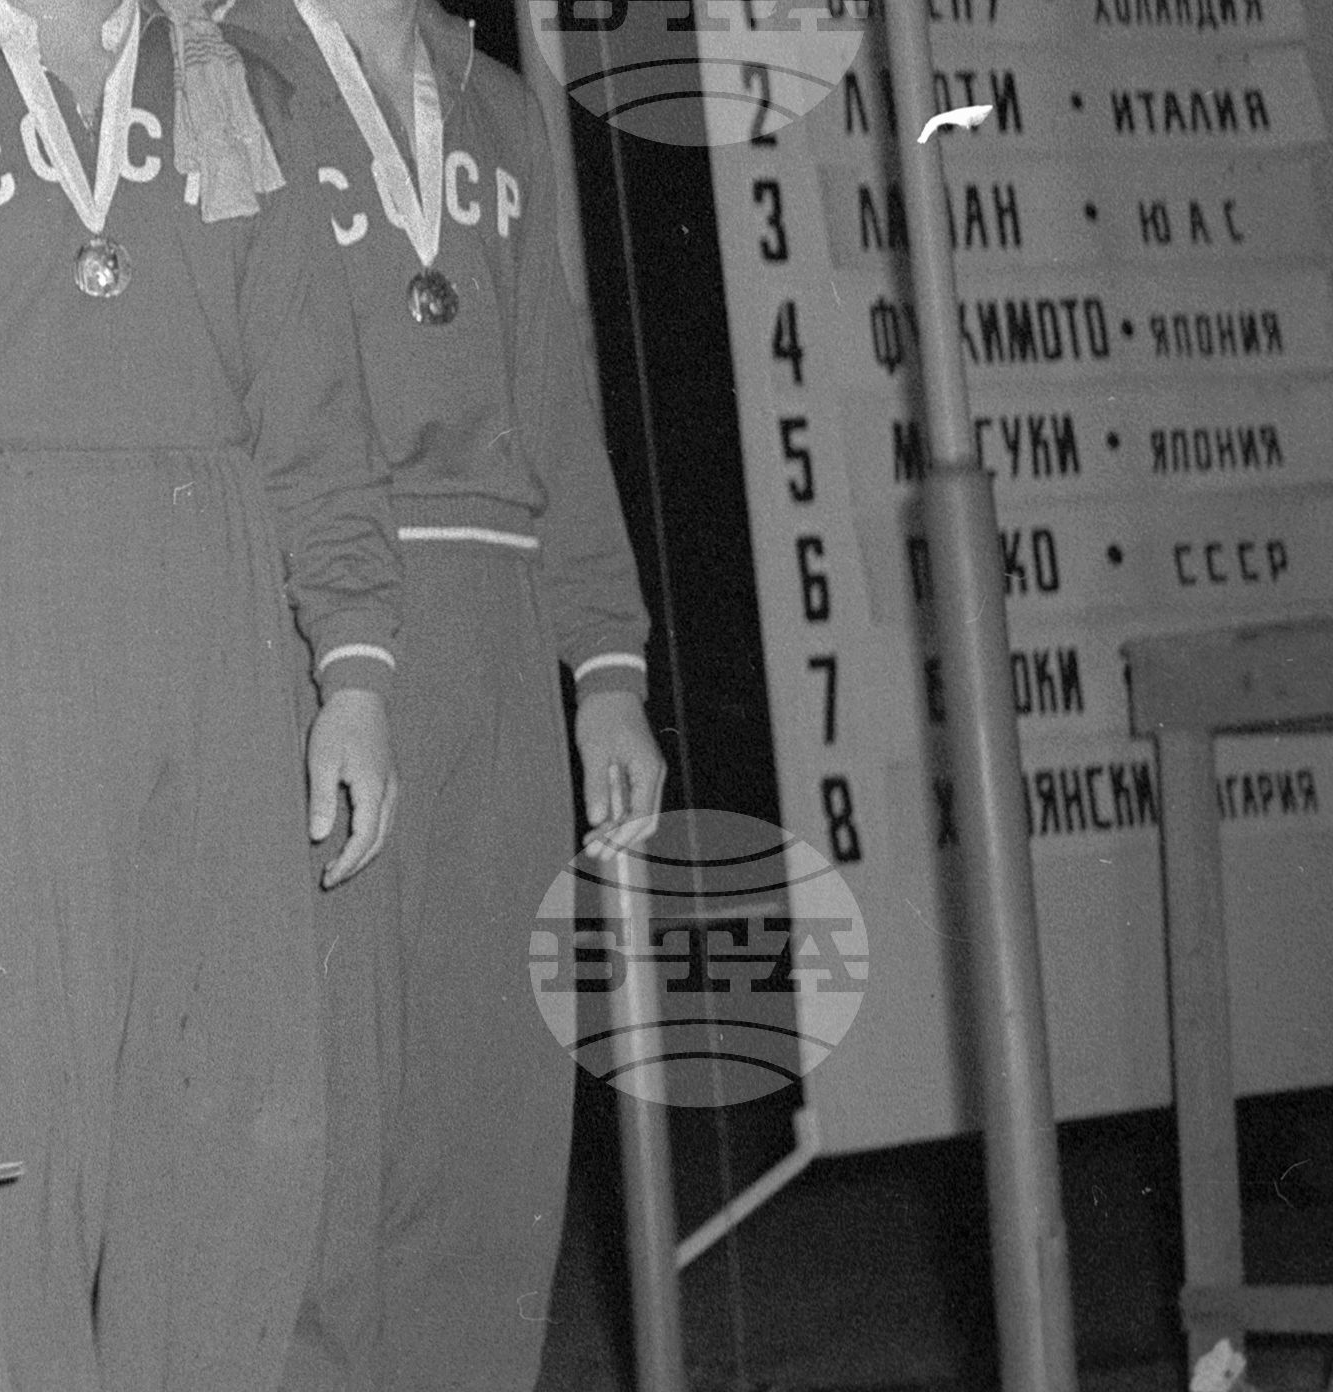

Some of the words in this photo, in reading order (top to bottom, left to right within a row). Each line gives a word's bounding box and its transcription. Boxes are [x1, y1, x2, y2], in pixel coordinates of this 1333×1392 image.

[741, 61, 778, 146] 2
[1111, 90, 1270, 134] ИТАЛИЯ
[753, 178, 788, 263] 3
[773, 301, 803, 385] 4
[1149, 310, 1284, 357] ЯПОНИЯ
[779, 416, 815, 503] 5
[1150, 425, 1283, 474] ЯПОНИЯ
[795, 536, 830, 622] 6
[1174, 541, 1288, 586] СССР
[808, 655, 837, 745] 7
[820, 774, 862, 864] 8
